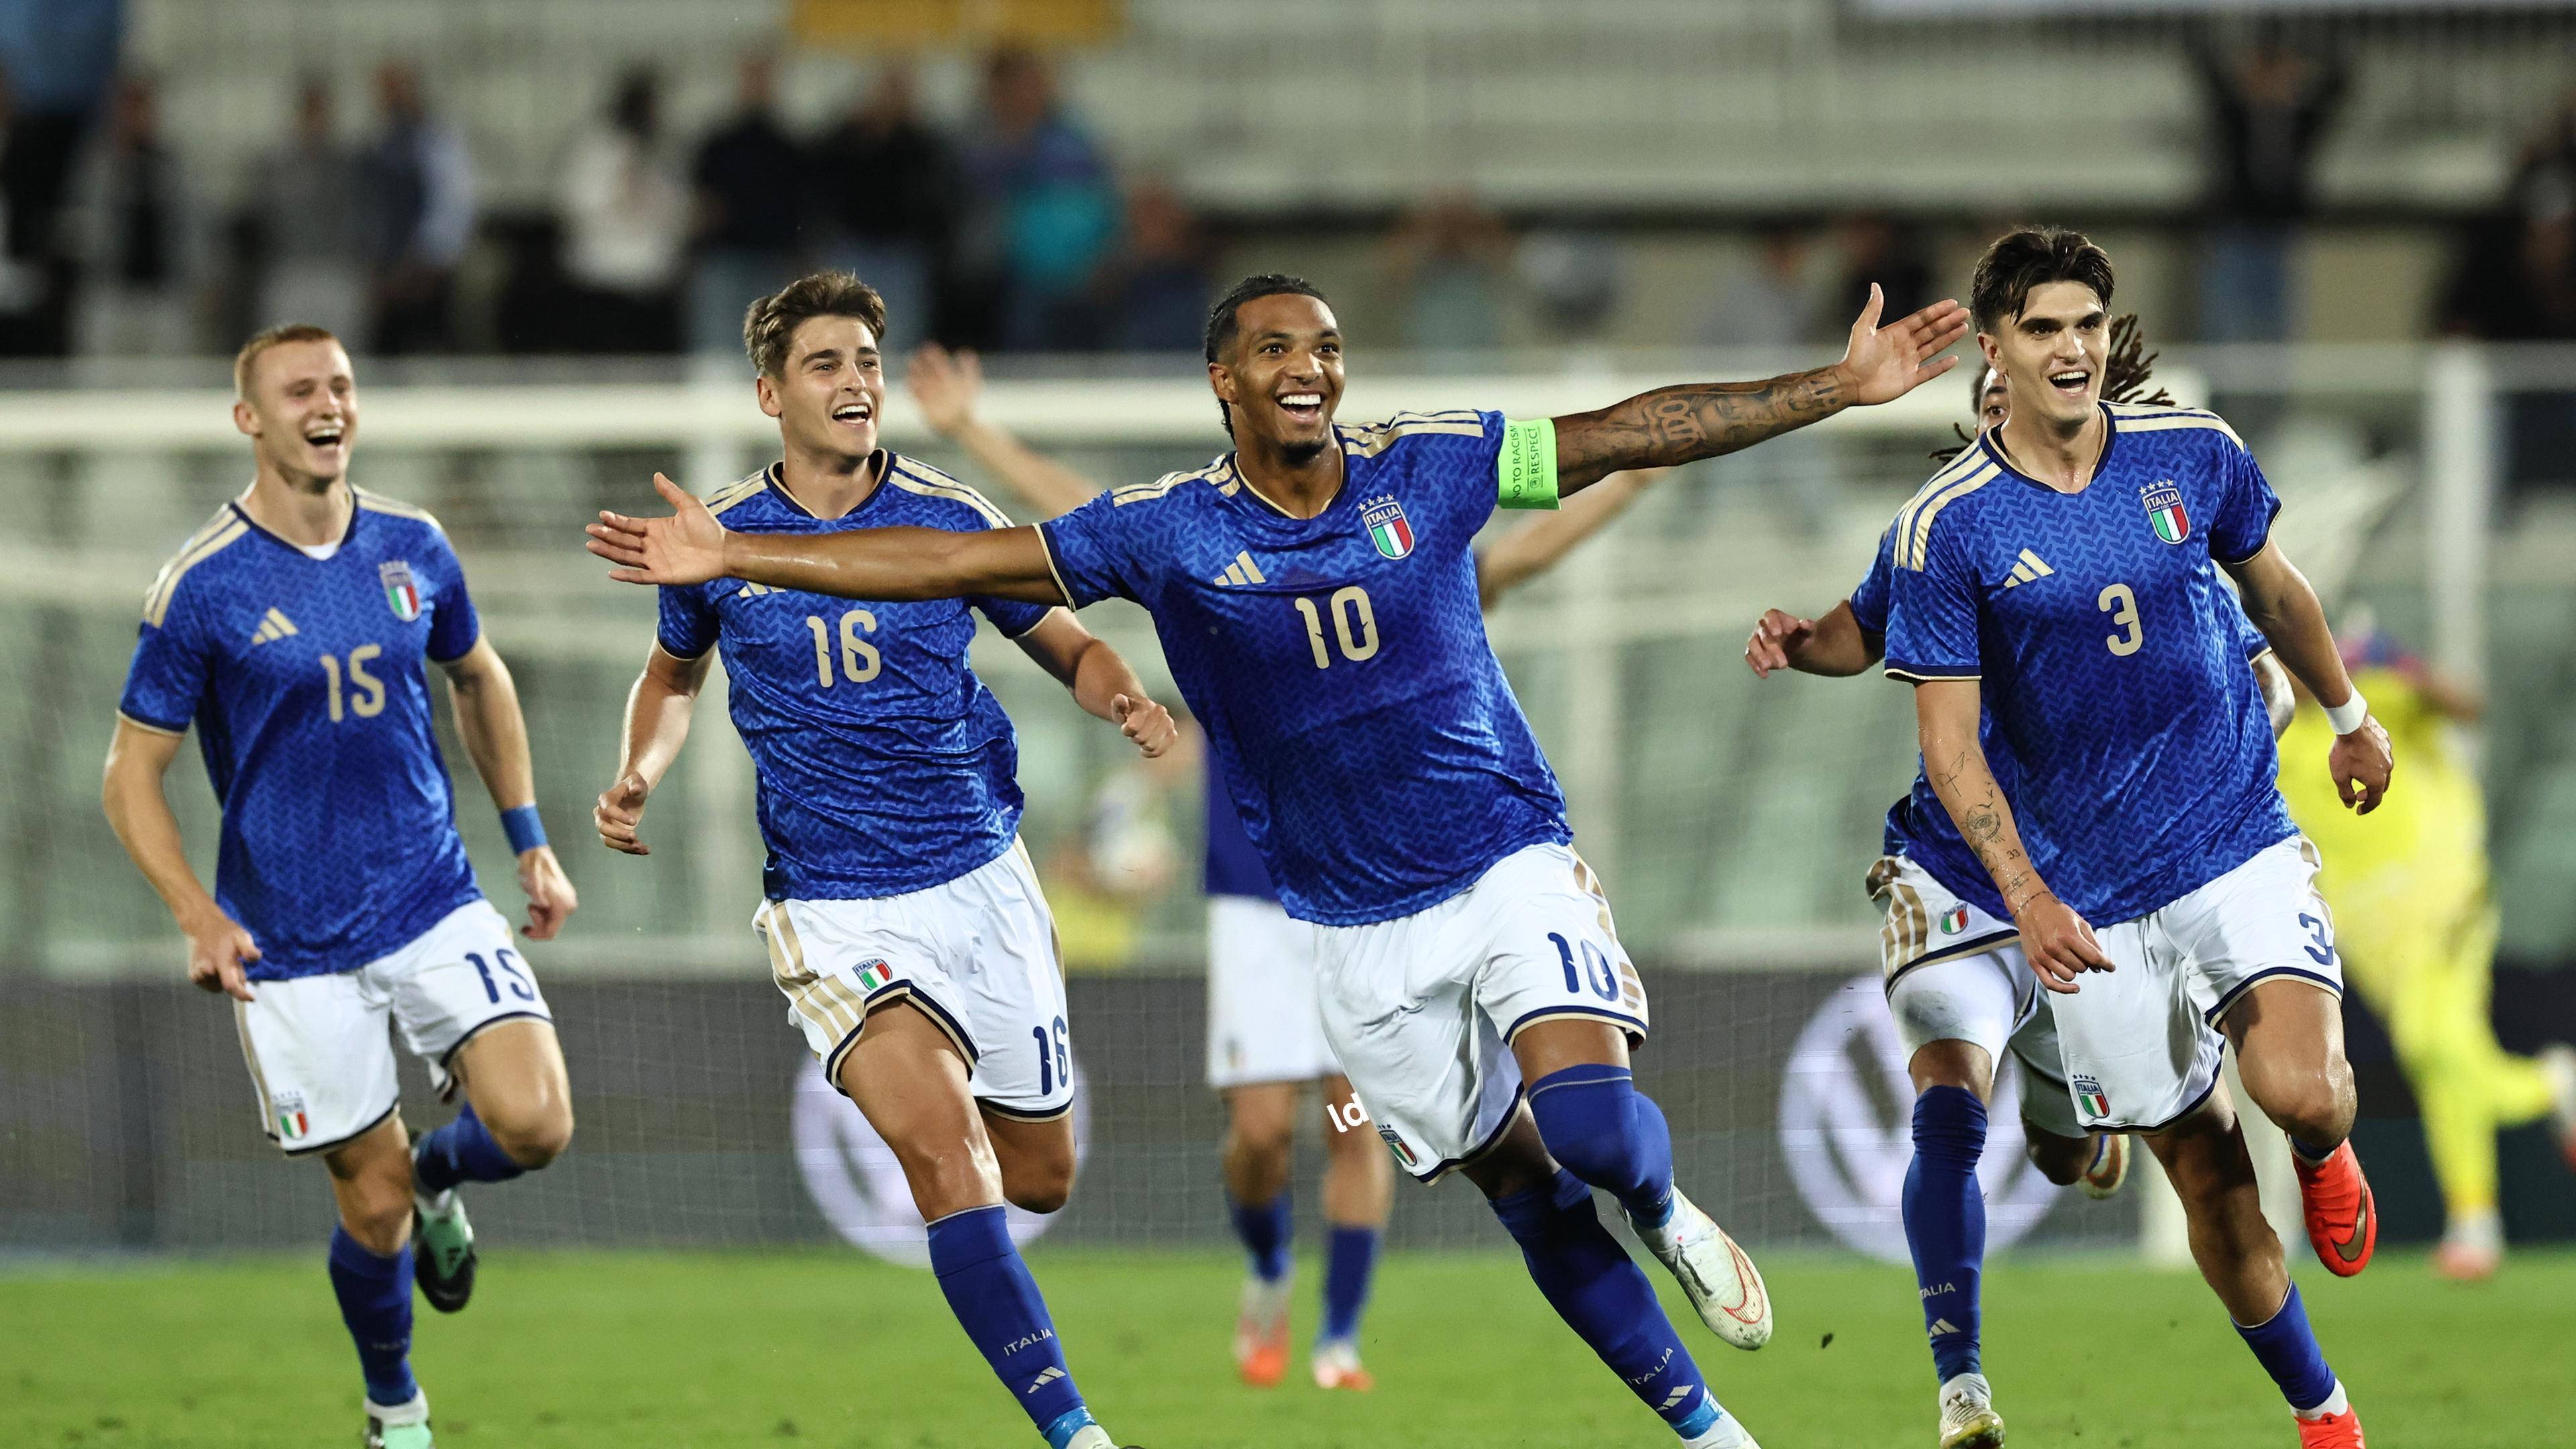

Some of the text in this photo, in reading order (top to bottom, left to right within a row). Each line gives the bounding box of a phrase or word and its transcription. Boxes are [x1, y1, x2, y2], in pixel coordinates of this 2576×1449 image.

[1527, 428, 1540, 474] RESPECT
[1513, 468, 1521, 483] TO
[1513, 484, 1521, 498] NO
[1366, 506, 1399, 525] ITALIA
[2147, 492, 2178, 508] ITALIA
[1295, 586, 1380, 669] 10
[2098, 583, 2143, 657] 3
[806, 609, 881, 688] 16
[320, 643, 385, 722] 15
[2006, 849, 2021, 860] 33
[2298, 912, 2334, 966] 3
[465, 949, 535, 1004] 15
[855, 959, 879, 973] ITALIA
[1548, 932, 1619, 1002] 10
[1033, 1014, 1067, 1095] 16
[2077, 1083, 2100, 1092] ITALIA
[1919, 1282, 1956, 1299] TALIA
[1004, 1328, 1053, 1356] ITALIA
[1627, 1348, 1673, 1385] ITALIA
